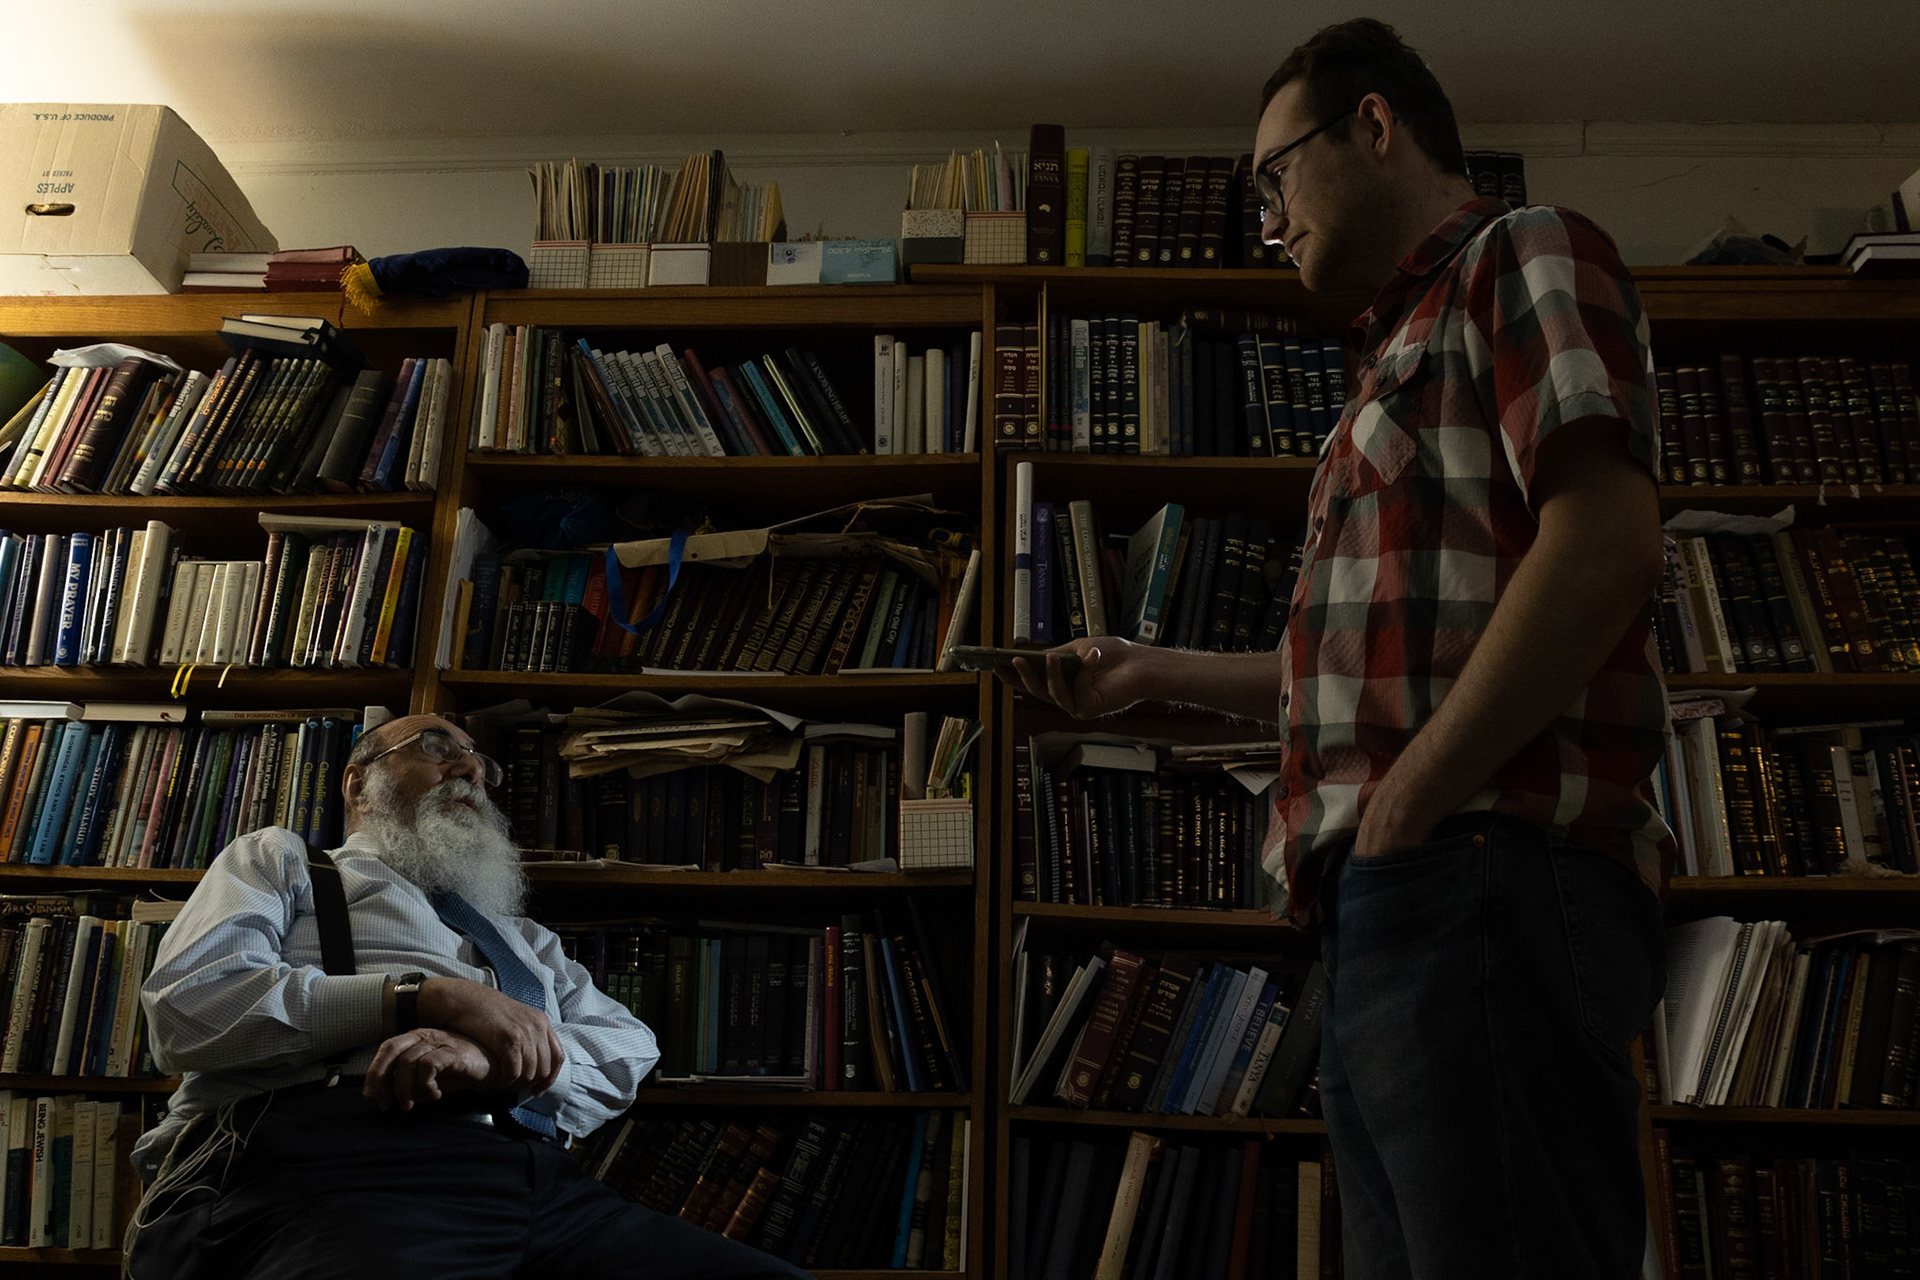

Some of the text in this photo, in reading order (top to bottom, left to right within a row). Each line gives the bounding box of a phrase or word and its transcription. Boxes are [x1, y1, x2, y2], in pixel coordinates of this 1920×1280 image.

[1034, 159, 1059, 171] תניא
[36, 182, 74, 192] APPLES
[186, 201, 225, 253] Quality
[808, 360, 851, 426] A KNOWING HEART
[359, 551, 373, 579] SOCIAL
[569, 569, 579, 585] THE
[1036, 560, 1047, 587] TANYA
[1079, 514, 1097, 608] THE LONG SHORTER WAY
[62, 563, 81, 630] MY PRAYER
[353, 580, 367, 609] VISION
[589, 572, 605, 615] THE MIDR
[838, 582, 869, 643] TORAH
[885, 583, 908, 644] From The Old City
[267, 737, 277, 762] Prince
[281, 747, 294, 780] RETURN
[38, 734, 75, 854] BIOMEDICAL ETHICS AND JEWISH LAW
[261, 773, 271, 800] Prison
[294, 760, 313, 832] Chassidic Gems
[310, 760, 329, 831] Chassidic Gems
[75, 765, 102, 846] STUDY TALMUD
[275, 788, 287, 822] SOURCE
[1, 903, 72, 915] ZERA SHIMSHON
[123, 948, 132, 964] Rabbi
[115, 997, 124, 1017] Mendel
[729, 995, 738, 1026] ההלכה
[750, 995, 759, 1026] ההלכה
[4, 993, 25, 1058] HOLOCAUST
[1240, 1007, 1265, 1052] BELIEVE
[1247, 1050, 1269, 1084] TANYA
[34, 1103, 46, 1162] BEING JEWISH
